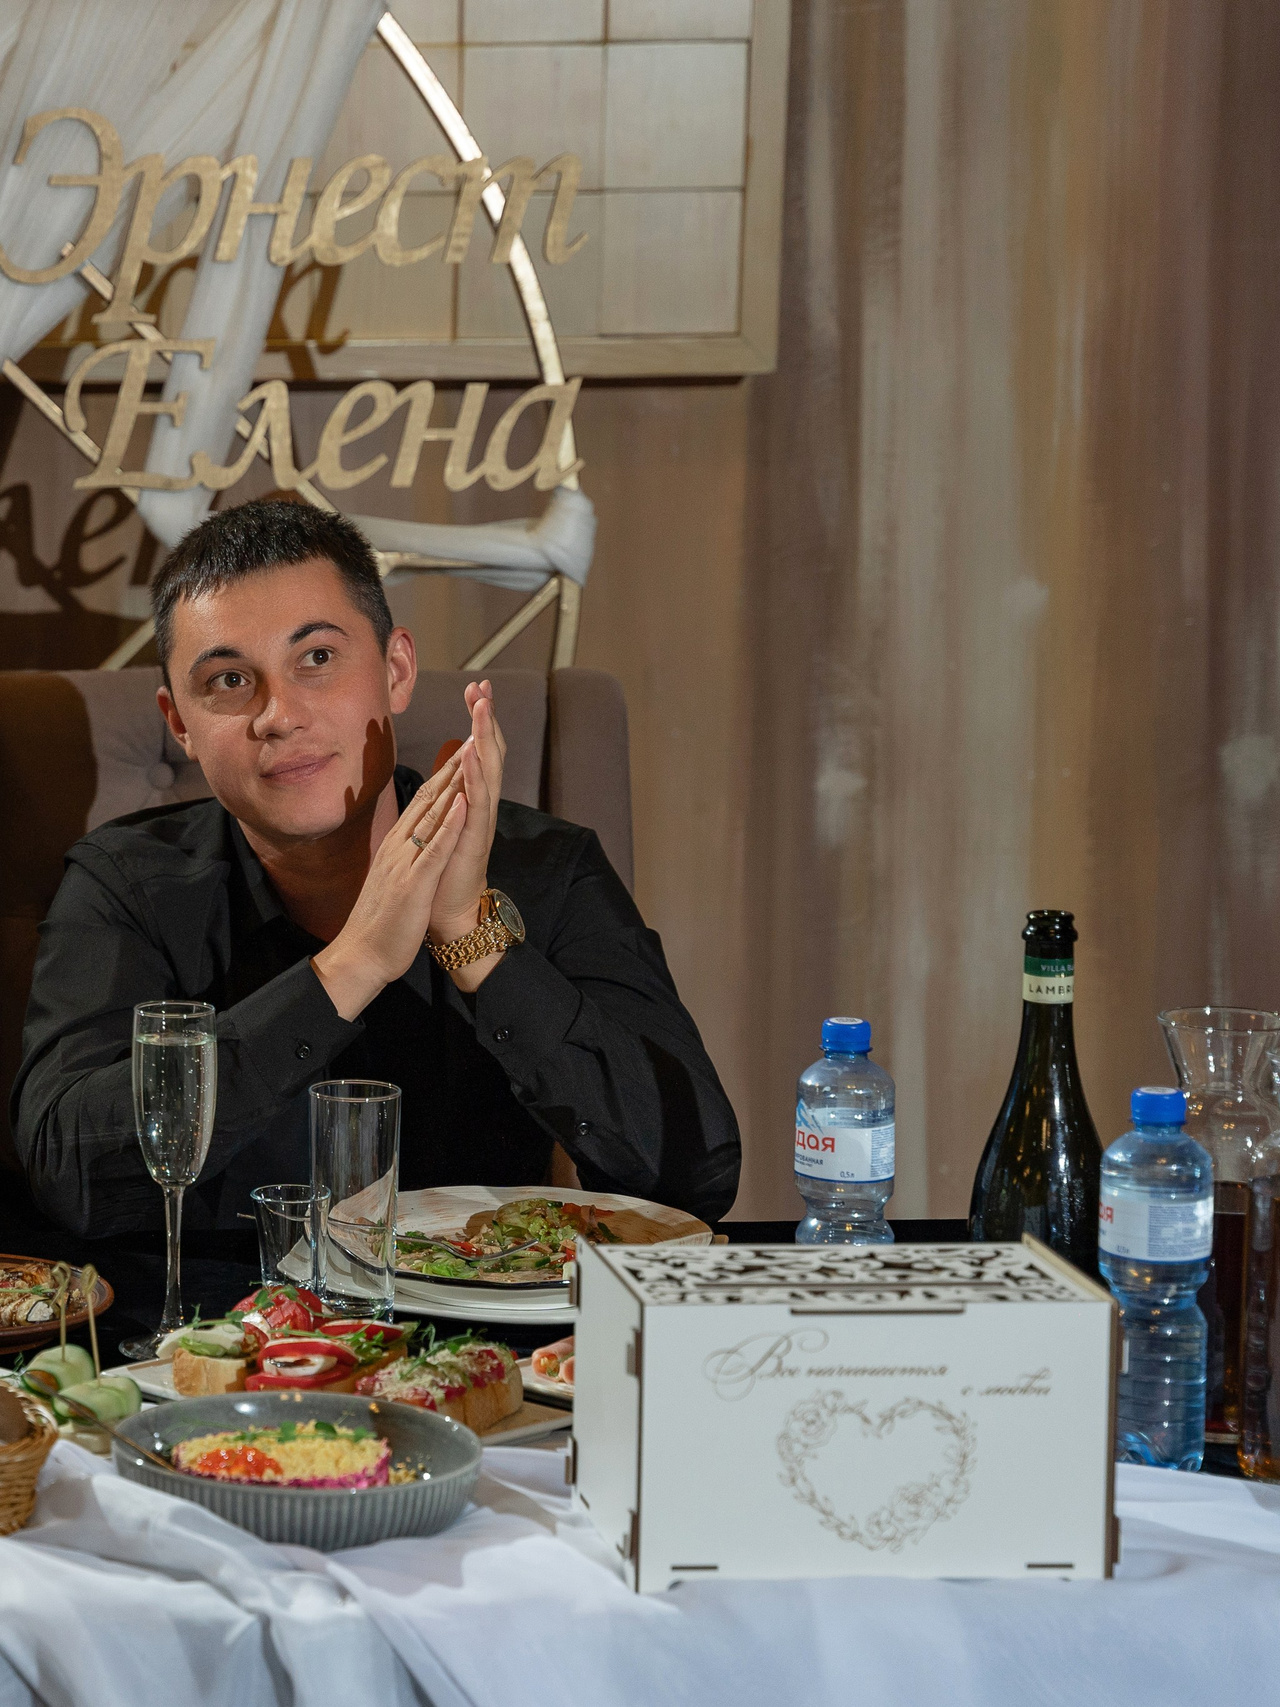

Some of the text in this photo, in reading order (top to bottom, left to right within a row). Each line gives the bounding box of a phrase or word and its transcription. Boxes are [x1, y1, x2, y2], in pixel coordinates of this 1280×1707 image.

[63, 336, 585, 492] Елена
[1040, 964, 1066, 972] VILLA
[1028, 983, 1074, 995] LAMBR
[795, 1129, 835, 1153] дая
[840, 1171, 855, 1179] 0,5л
